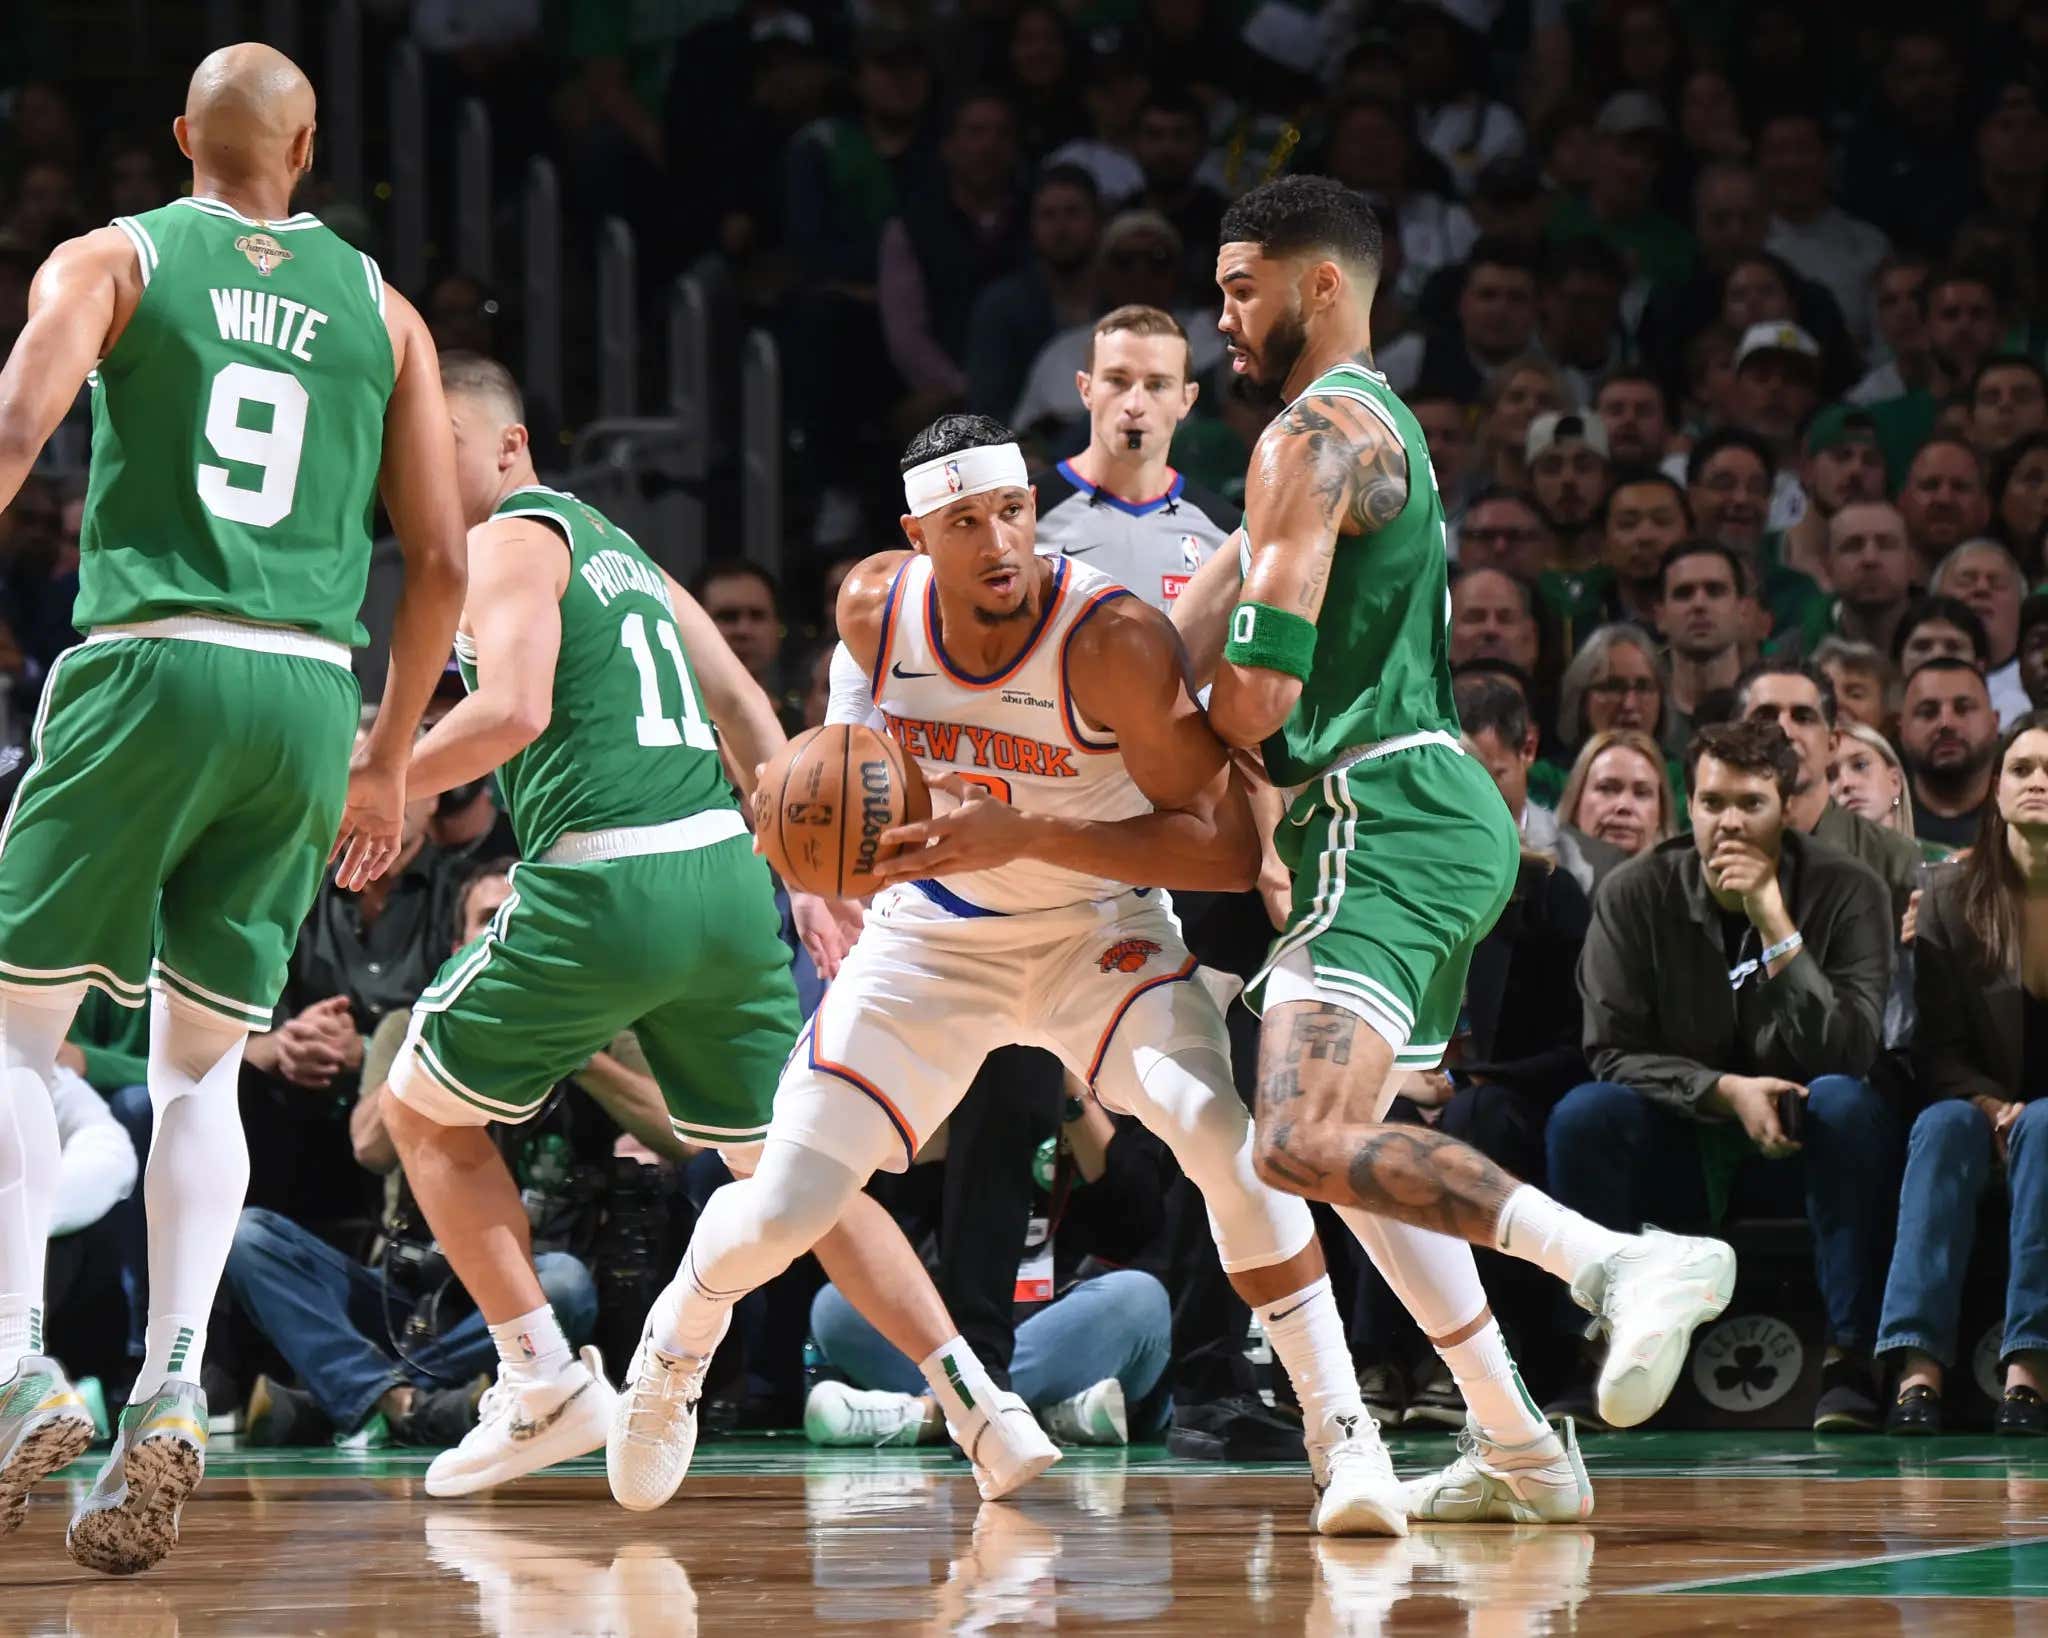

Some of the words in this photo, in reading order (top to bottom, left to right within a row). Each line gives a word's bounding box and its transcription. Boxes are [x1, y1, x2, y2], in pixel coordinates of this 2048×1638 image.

[208, 288, 329, 362] WHITE
[196, 361, 310, 529] 9
[1233, 605, 1257, 644] 0
[620, 612, 719, 751] 11
[1001, 695, 1022, 704] abu
[964, 726, 1079, 777] YORK
[852, 760, 892, 875] Wilson
[1702, 1320, 1797, 1359] CELTICS
